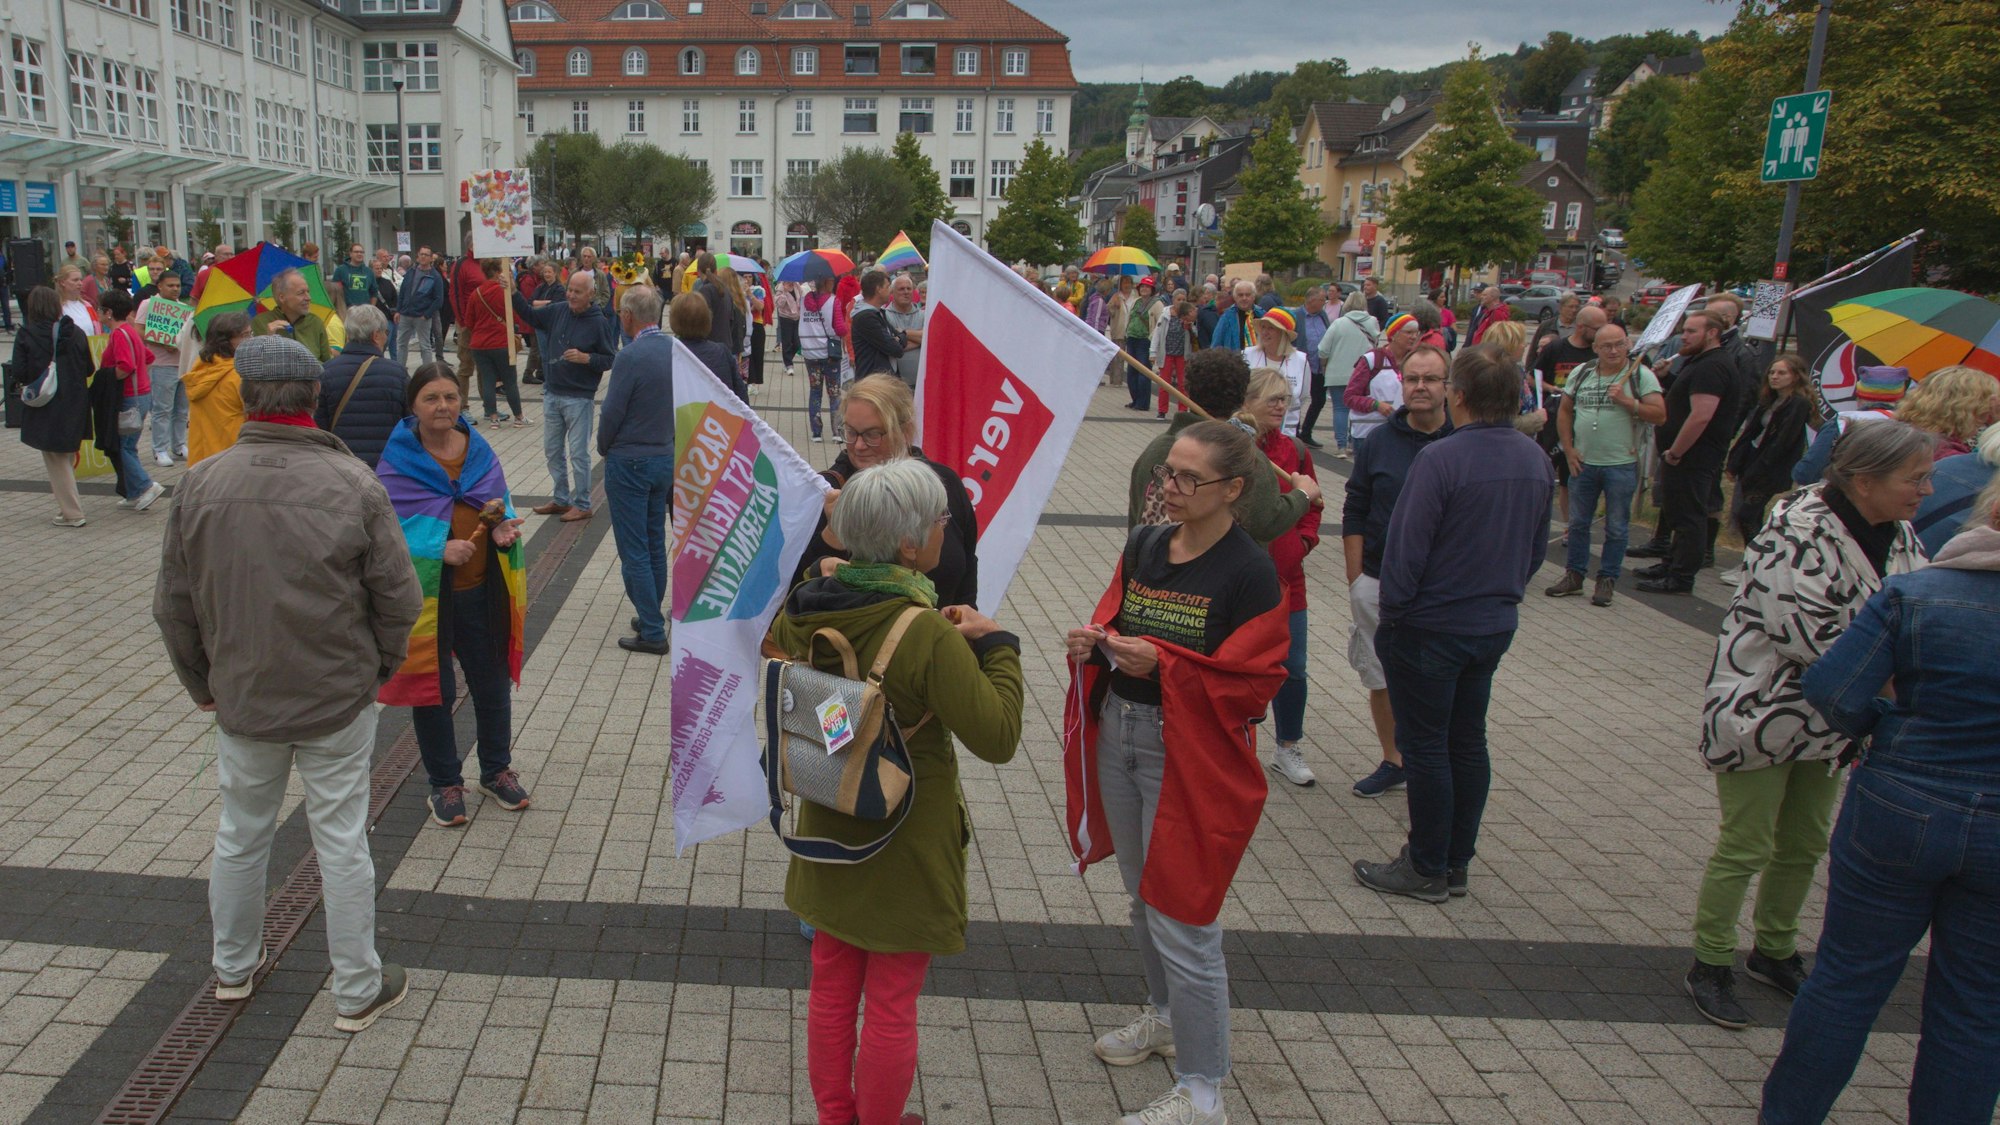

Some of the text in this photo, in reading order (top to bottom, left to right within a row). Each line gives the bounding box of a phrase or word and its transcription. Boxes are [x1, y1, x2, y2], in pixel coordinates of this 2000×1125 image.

[152, 301, 181, 319] HERZ
[147, 321, 169, 333] HASS
[148, 314, 171, 326] HIRN
[144, 330, 172, 345] AFD
[1811, 369, 1830, 415] ACTION
[1142, 607, 1206, 629] MEINUNG
